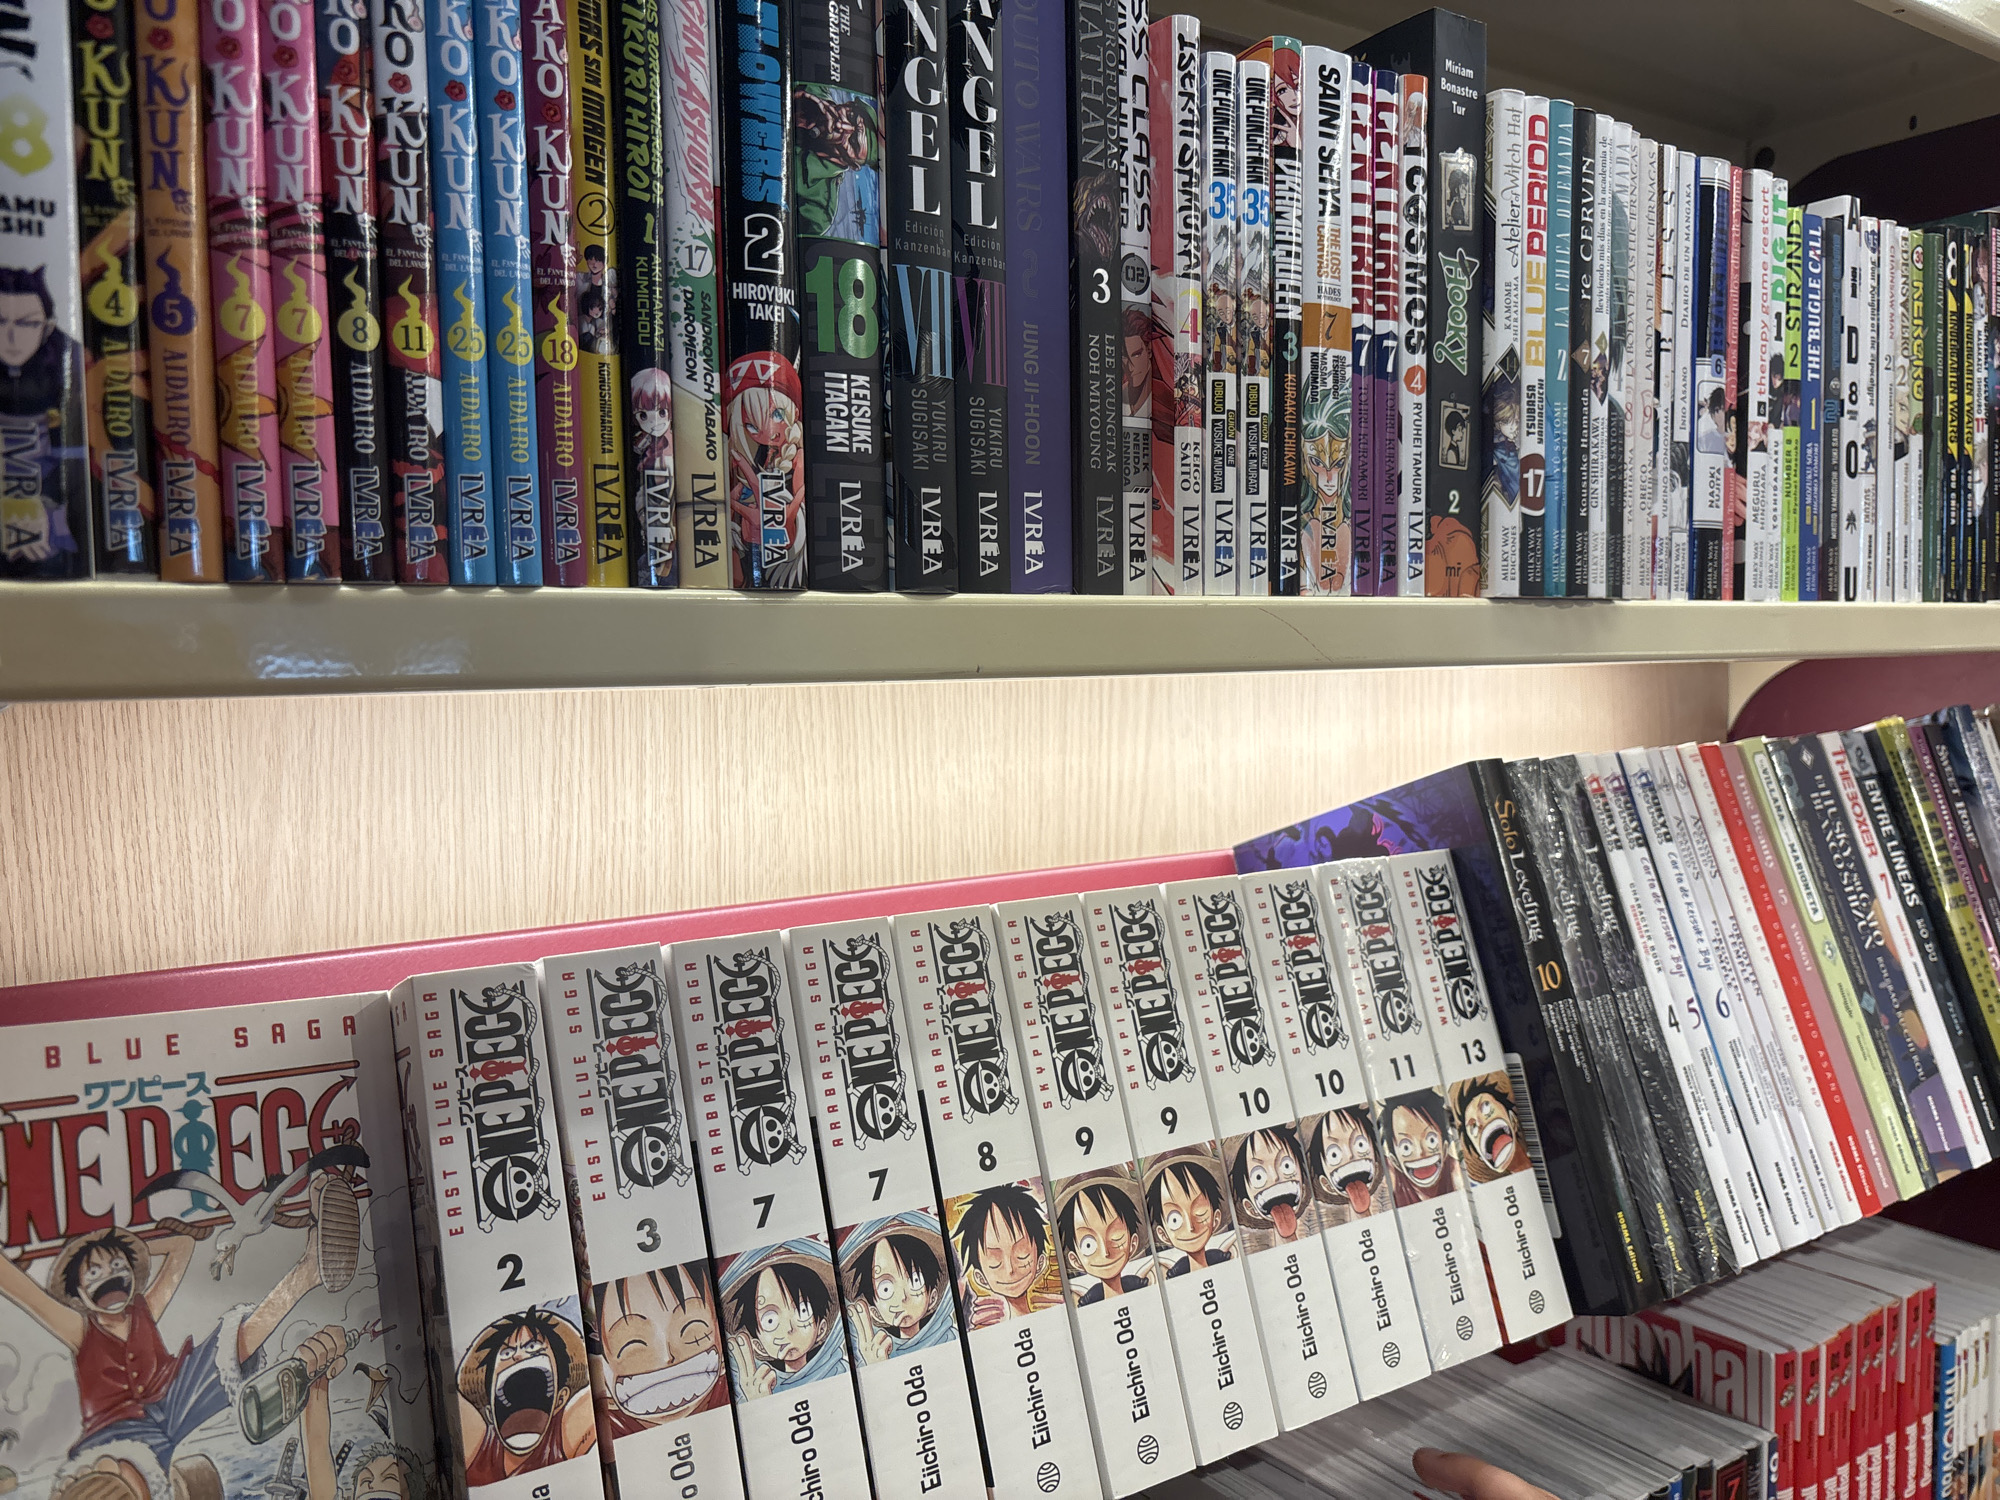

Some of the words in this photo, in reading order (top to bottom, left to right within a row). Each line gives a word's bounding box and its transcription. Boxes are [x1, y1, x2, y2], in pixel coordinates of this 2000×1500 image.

[829, 1, 841, 82] GRAPPLER
[1105, 19, 1119, 171] PROFUNDAS
[1440, 77, 1478, 99] Bonastre
[1446, 59, 1474, 80] Míriam
[79, 39, 131, 180] KUN
[141, 54, 191, 191] KUN
[1318, 64, 1341, 140] SAINT
[1451, 100, 1467, 116] Tur
[1507, 107, 1523, 137] Hat
[210, 62, 258, 198] KUN
[267, 71, 314, 203] KUN
[323, 84, 371, 214] KUN
[671, 45, 714, 242] ASHURA
[1318, 146, 1341, 217] SEIYA
[1501, 143, 1521, 200] Witch
[1527, 114, 1549, 258] PERIOD
[1209, 181, 1236, 220] 35
[1242, 188, 1270, 227] 35
[1580, 156, 1595, 263] CERVIN
[1762, 187, 1770, 260] restart
[744, 213, 784, 275] 2
[905, 220, 944, 237] Edición
[964, 234, 1001, 251] Edición
[1502, 200, 1521, 268] Atelier
[1809, 226, 1822, 275] CALL
[685, 244, 708, 272] 17
[1092, 268, 1111, 302] 3
[1555, 232, 1570, 292] CHICA
[1786, 220, 1802, 331] STRAND
[635, 256, 650, 345] KUMICHOU
[732, 282, 794, 306] HIROYUKI
[748, 302, 785, 322] TAKEI
[804, 256, 879, 358] 18
[1318, 286, 1341, 297] HADES
[1504, 281, 1512, 330] KAMOME
[1524, 260, 1546, 367] BLUE
[1581, 274, 1591, 301] re
[1681, 285, 1689, 328] DIARIO
[1761, 266, 1770, 315] game
[1807, 279, 1822, 342] BUGLE
[452, 327, 482, 354] 25
[501, 331, 530, 357] 25
[683, 289, 698, 382] DAROMEON
[701, 290, 715, 393] SANDROVICH
[1180, 309, 1200, 343] 4
[1555, 306, 1569, 328] LA
[549, 338, 573, 365] 18
[1023, 321, 1039, 375] JUNG
[1089, 334, 1100, 375] NOH
[1105, 334, 1115, 368] LEE
[1757, 321, 1770, 396] therapy
[1789, 343, 1798, 368] 2
[1807, 344, 1820, 382] THE
[102, 339, 132, 437] AIDAIRO
[162, 349, 191, 446] AIDAIRO
[1214, 381, 1223, 413] DIBUJO
[1248, 385, 1258, 416] DIBUJO
[1284, 374, 1296, 426] KURAKU
[1310, 352, 1318, 403] KURUMADA
[1332, 354, 1340, 400] TESHIROGI
[351, 361, 375, 453] AIDAIRO
[460, 372, 482, 461] AIDAIRO
[508, 376, 530, 463] AIDAIRO
[702, 397, 717, 461] YABAKO
[823, 372, 850, 453] ITAGAKI
[850, 374, 872, 454] KEISUKE
[911, 388, 929, 470] SUGISAKI
[931, 400, 947, 463] YUKIRU
[1024, 381, 1040, 465] JI-HOON
[1090, 381, 1101, 469] MIYOUNG
[1105, 373, 1116, 473] KYUNGTAK
[1413, 402, 1423, 450] RYUHEI
[1526, 384, 1536, 437] TSUBASA
[1580, 388, 1589, 449] Hamada
[969, 397, 986, 476] SUGISAKI
[989, 407, 1003, 469] YUKIRU
[1123, 431, 1131, 487] SINNOA
[1214, 421, 1223, 456] YUSUKE
[1248, 424, 1258, 457] YUSUKE
[1284, 428, 1296, 485] ICHIKAWA
[1591, 417, 1600, 486] SHIRAKAWA
[1181, 442, 1191, 492] SAITO
[1214, 458, 1223, 492] MURATA
[1248, 461, 1258, 494] MURATA
[1412, 452, 1423, 504] TAMURA
[1523, 468, 1544, 498] 17
[1579, 454, 1588, 517] Kousuke
[1639, 463, 1648, 511] ORECO
[1449, 490, 1460, 513] 2
[1590, 487, 1598, 509] GIN
[1752, 470, 1760, 524] MEGURU
[1494, 794, 1517, 851] Solo
[1509, 851, 1544, 945] Leveling
[1863, 779, 1894, 837] ENTRE
[1887, 841, 1920, 907] LÍNEAS
[1788, 842, 1819, 916] MARIONETA
[1093, 908, 1114, 965] SAGA
[1629, 882, 1653, 941] CHARACTER
[802, 946, 822, 1003] SAGA
[911, 928, 930, 983] SAGA
[1008, 920, 1028, 979] SAGA
[1536, 960, 1562, 992] 10
[561, 972, 583, 1034] SAGA
[684, 961, 704, 1022] SAGA
[1668, 1004, 1681, 1033] 4
[1686, 997, 1702, 1029] 5
[1715, 987, 1731, 1019] 6
[45, 1033, 181, 1069] BLUE
[234, 1015, 357, 1048] SAGA
[923, 1001, 954, 1121] ARABASTA
[1023, 1000, 1053, 1110] SKYPIEA
[1109, 985, 1140, 1090] SKYPIEA
[1461, 1038, 1488, 1065] 13
[84, 1070, 212, 1110] ワンピース
[573, 1054, 594, 1118] BLUE
[813, 1022, 844, 1148] ARABASTA
[1314, 1068, 1345, 1098] 10
[1389, 1053, 1417, 1082] 11
[695, 1041, 728, 1174] ARABASTA
[1160, 1105, 1179, 1135] 9
[1238, 1086, 1271, 1118] 10
[977, 1141, 997, 1172] 8
[1075, 1126, 1094, 1156] 9
[585, 1138, 607, 1202] EAST
[868, 1168, 889, 1202] 7
[752, 1193, 776, 1230] 7
[1506, 1185, 1525, 1216] Oda
[636, 1218, 662, 1253] 3
[1516, 1218, 1537, 1281] Eiichiro
[1617, 1211, 1630, 1246] NORMA
[1627, 1243, 1643, 1283] Editorial
[496, 1253, 527, 1292] 2
[1199, 1278, 1220, 1317] Oda
[1014, 1328, 1037, 1369] Oda
[1113, 1305, 1135, 1346] Oda
[1211, 1319, 1235, 1391] Eiichiro
[904, 1364, 928, 1408] Oda
[1026, 1371, 1052, 1449] Eiichiro
[1125, 1348, 1151, 1423] Eiichiro
[915, 1410, 942, 1494] Eiichiro
